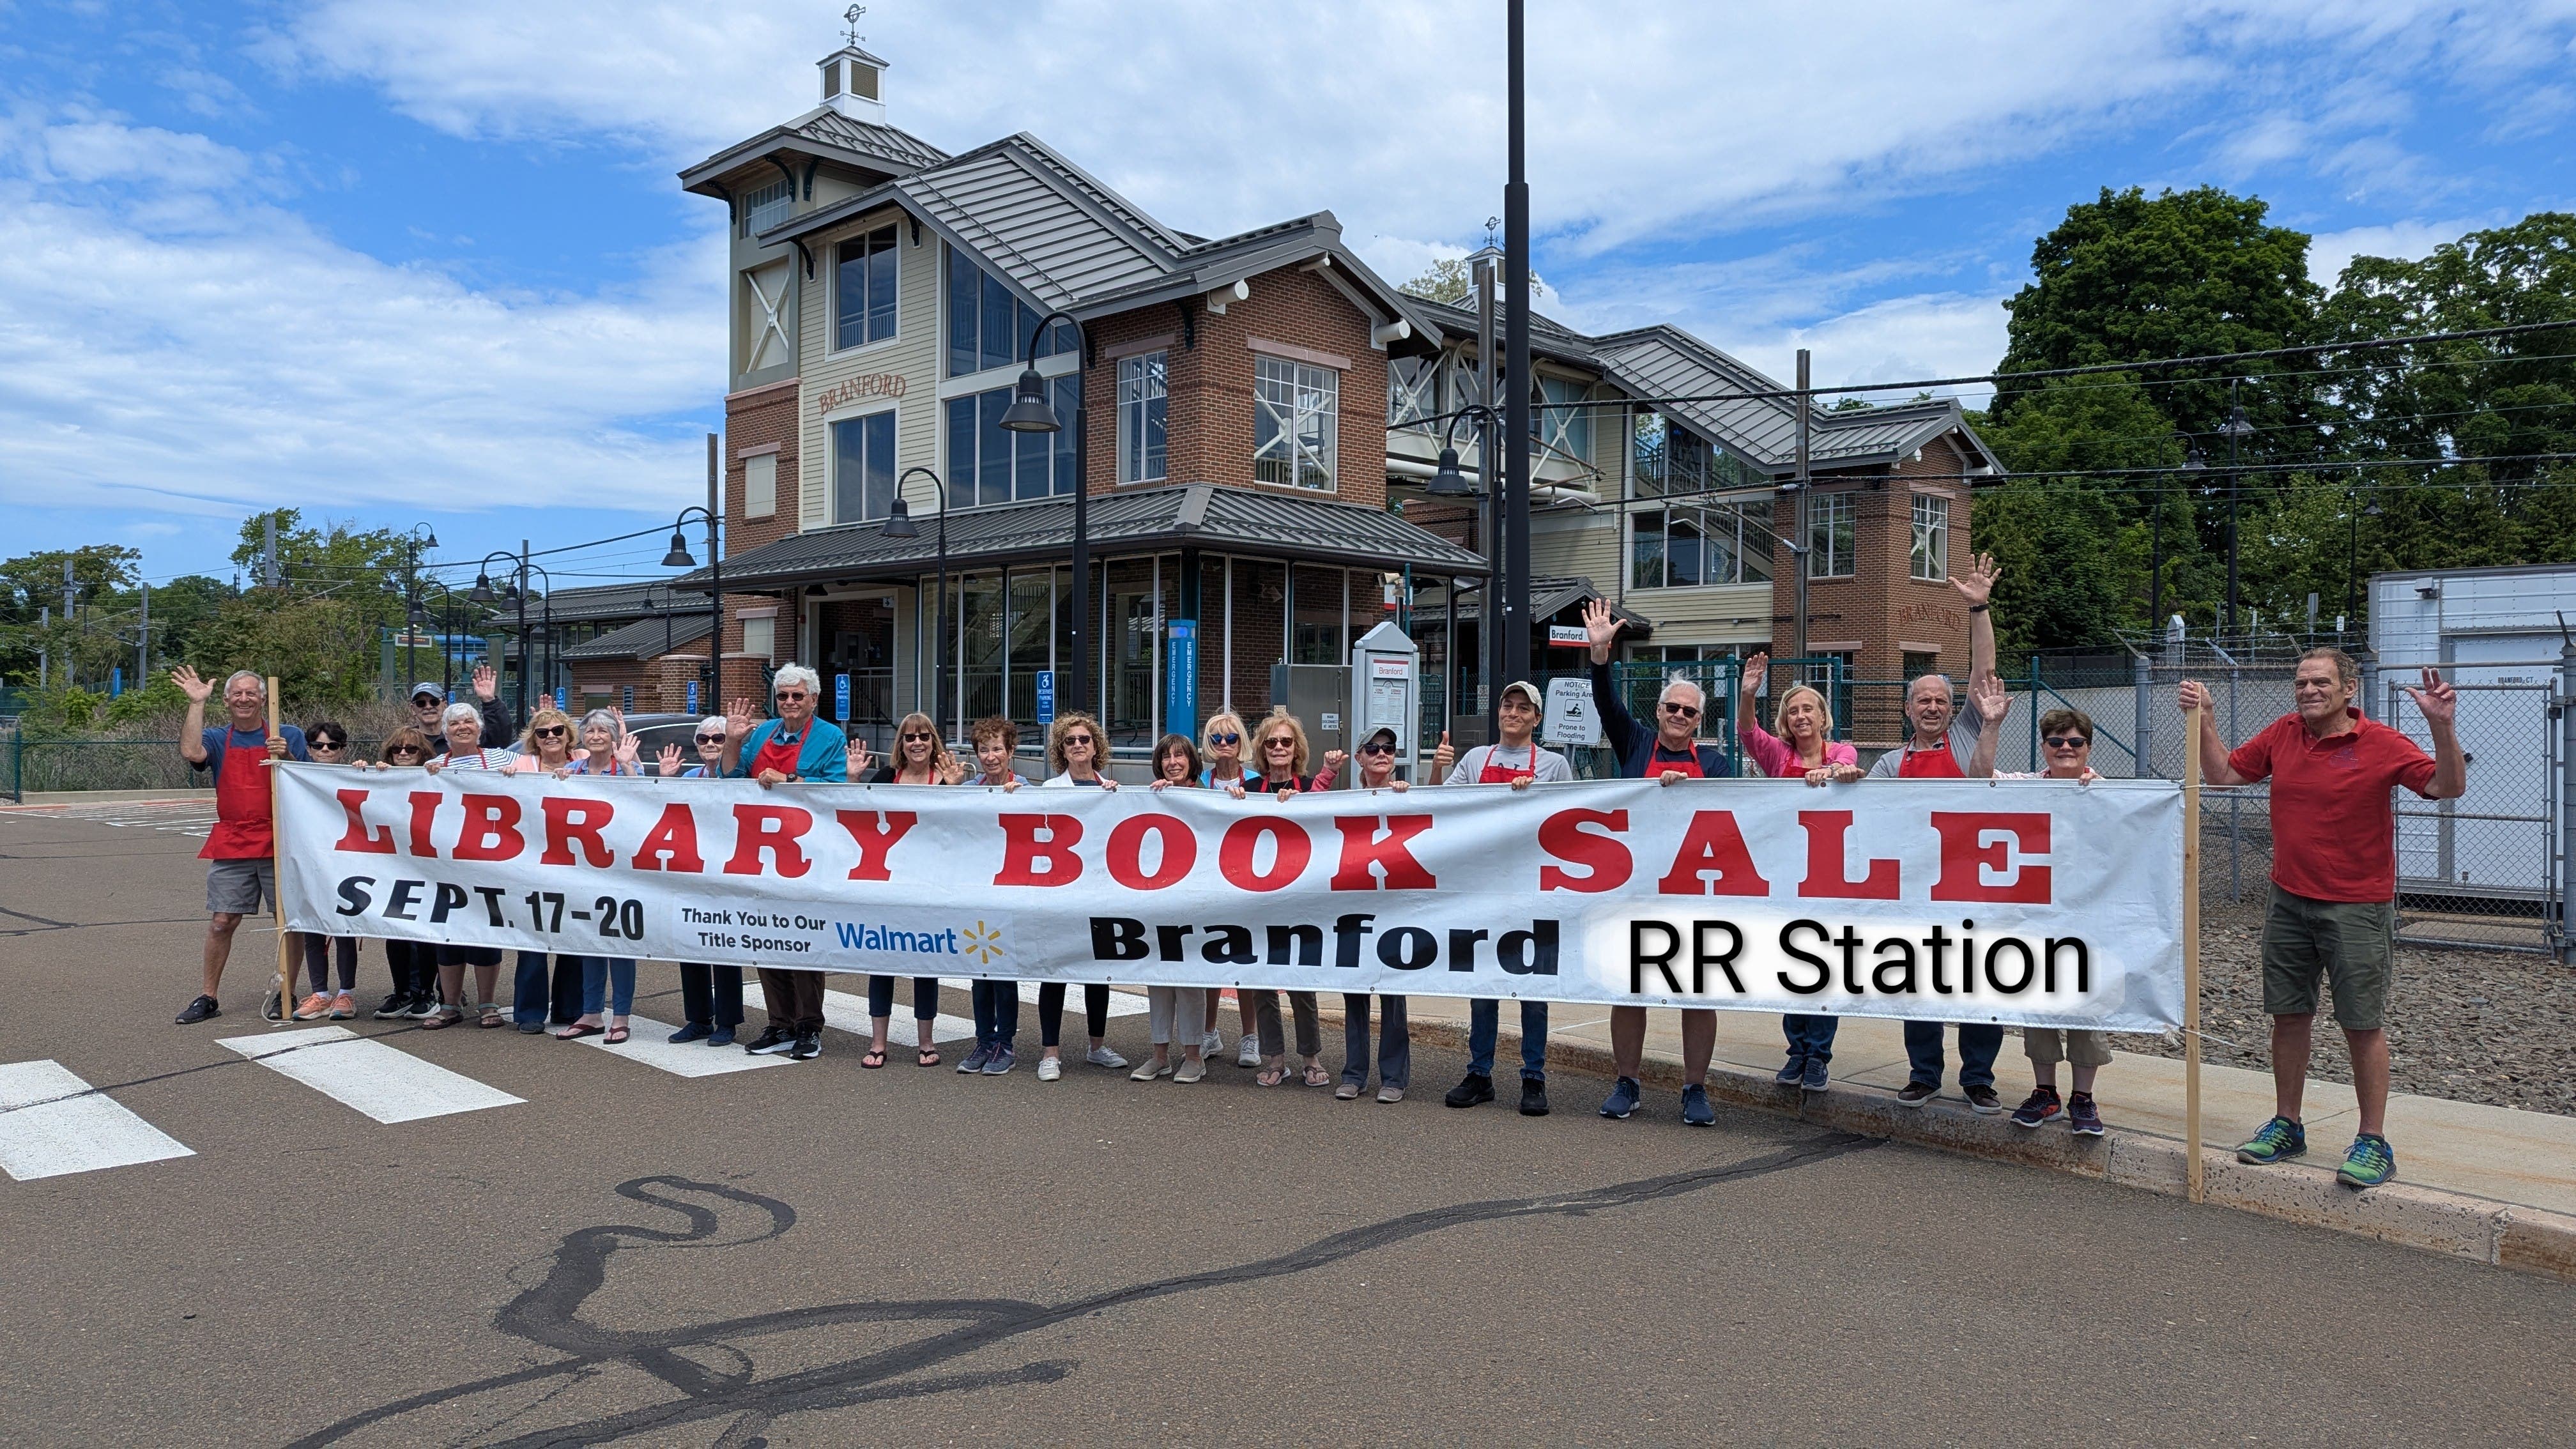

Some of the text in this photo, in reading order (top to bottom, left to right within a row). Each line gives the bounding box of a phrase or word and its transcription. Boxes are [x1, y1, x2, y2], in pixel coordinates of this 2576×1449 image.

[818, 374, 906, 415] BRANFORD
[1899, 602, 1961, 632] BRANFORD
[1551, 629, 1583, 640] Branford
[1379, 666, 1403, 675] Branford
[1555, 689, 1580, 698] Parking
[1557, 731, 1585, 740] Flooding
[335, 788, 2051, 904] LIBRARY BOOK SALE
[335, 875, 645, 941] SEPT. 17-20
[682, 908, 826, 931] Thank You to Our
[698, 932, 811, 953] Title Sponsor
[835, 921, 960, 955] Walmart
[1088, 913, 1560, 976] Branford
